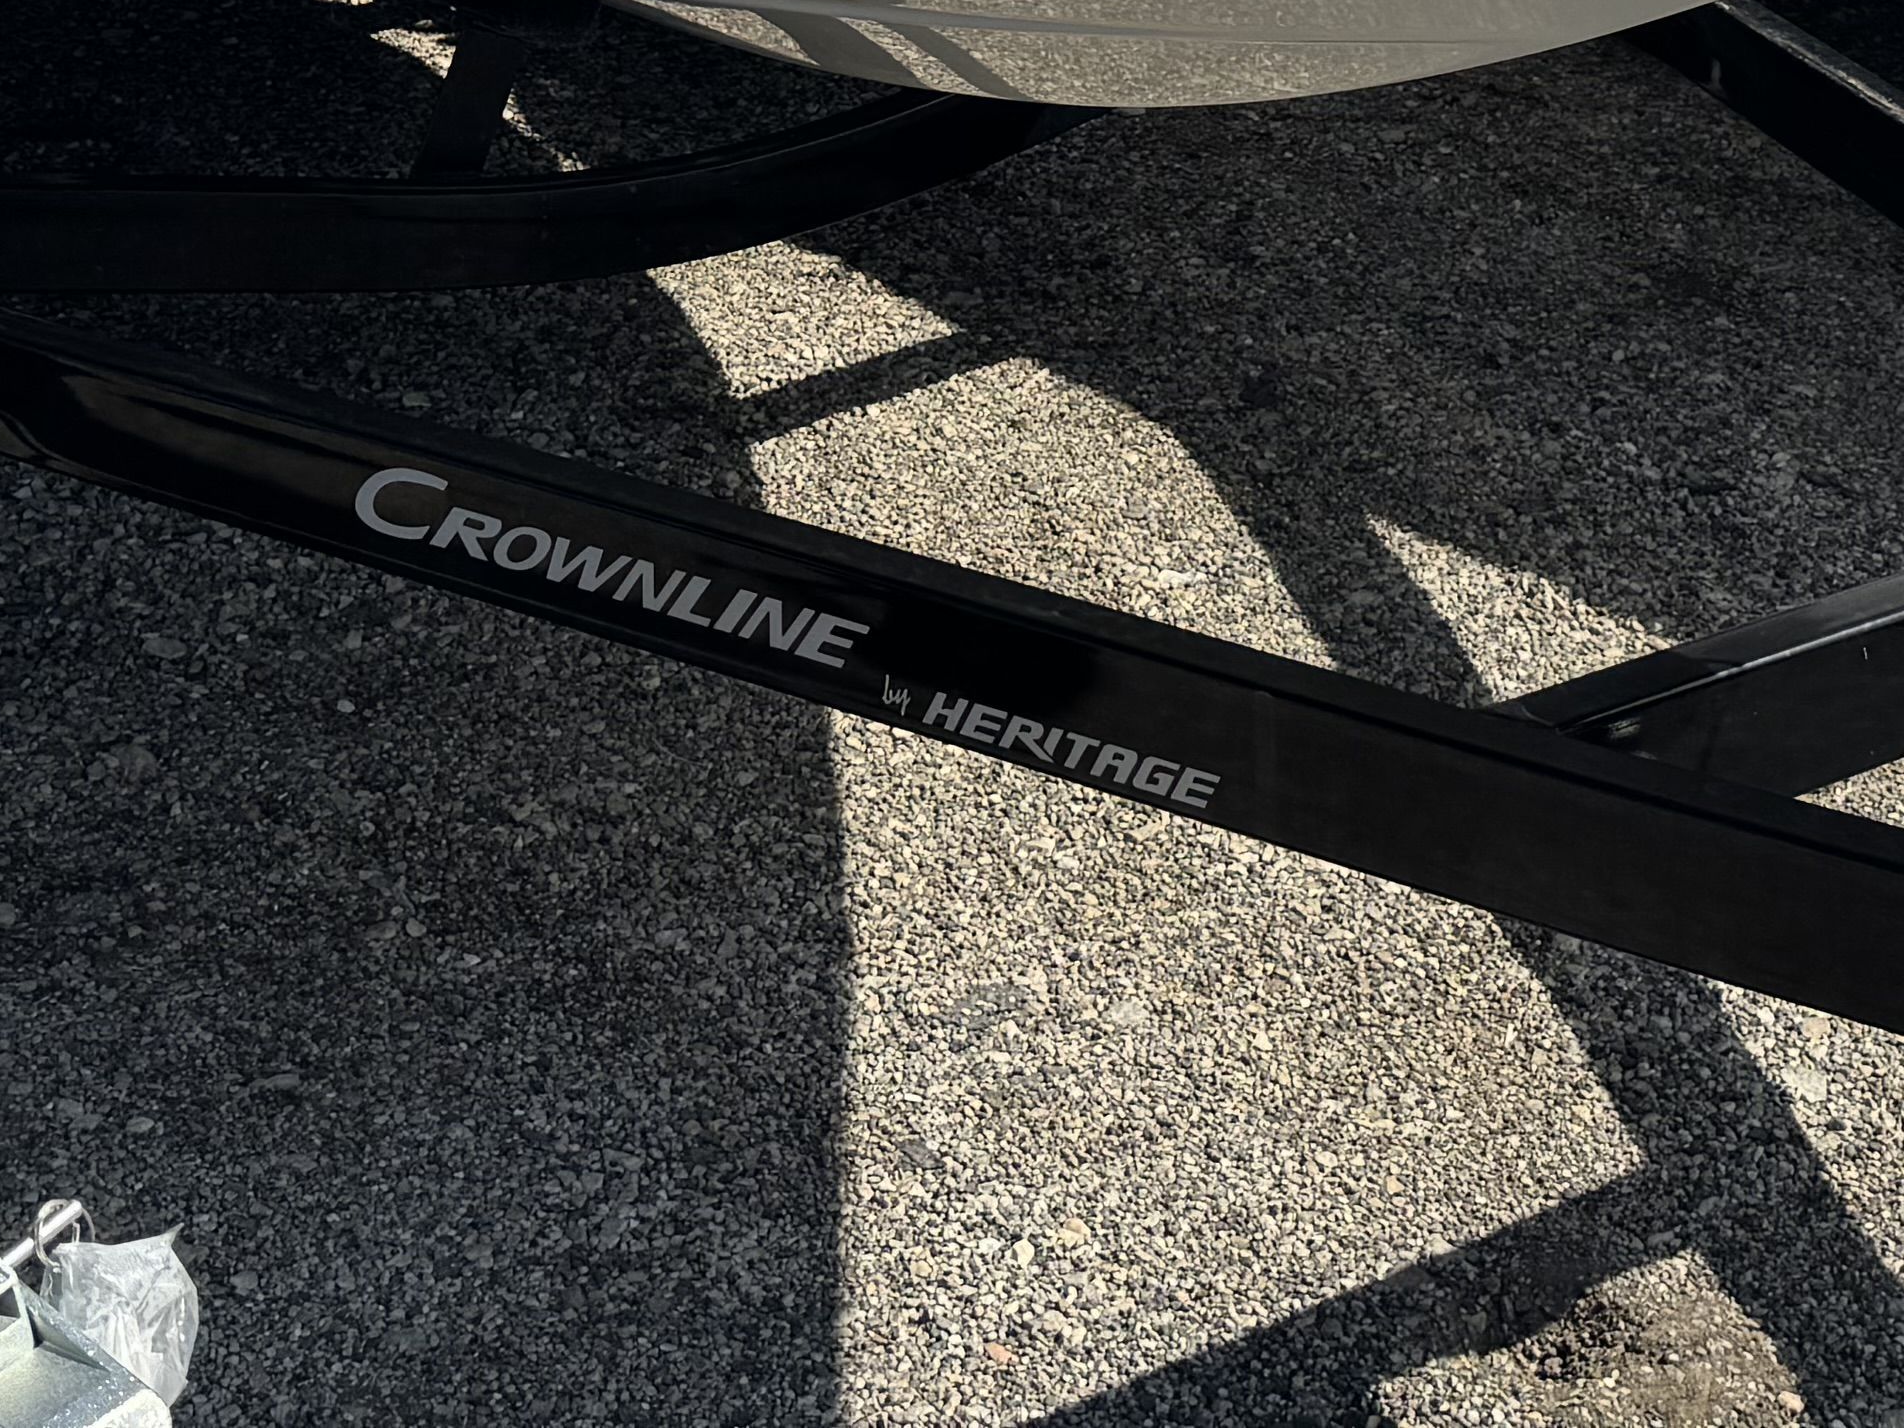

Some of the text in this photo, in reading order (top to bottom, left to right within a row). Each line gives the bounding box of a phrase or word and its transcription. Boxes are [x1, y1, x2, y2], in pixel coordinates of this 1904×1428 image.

[354, 466, 1223, 810] CROWNLINE by HERITAGE
